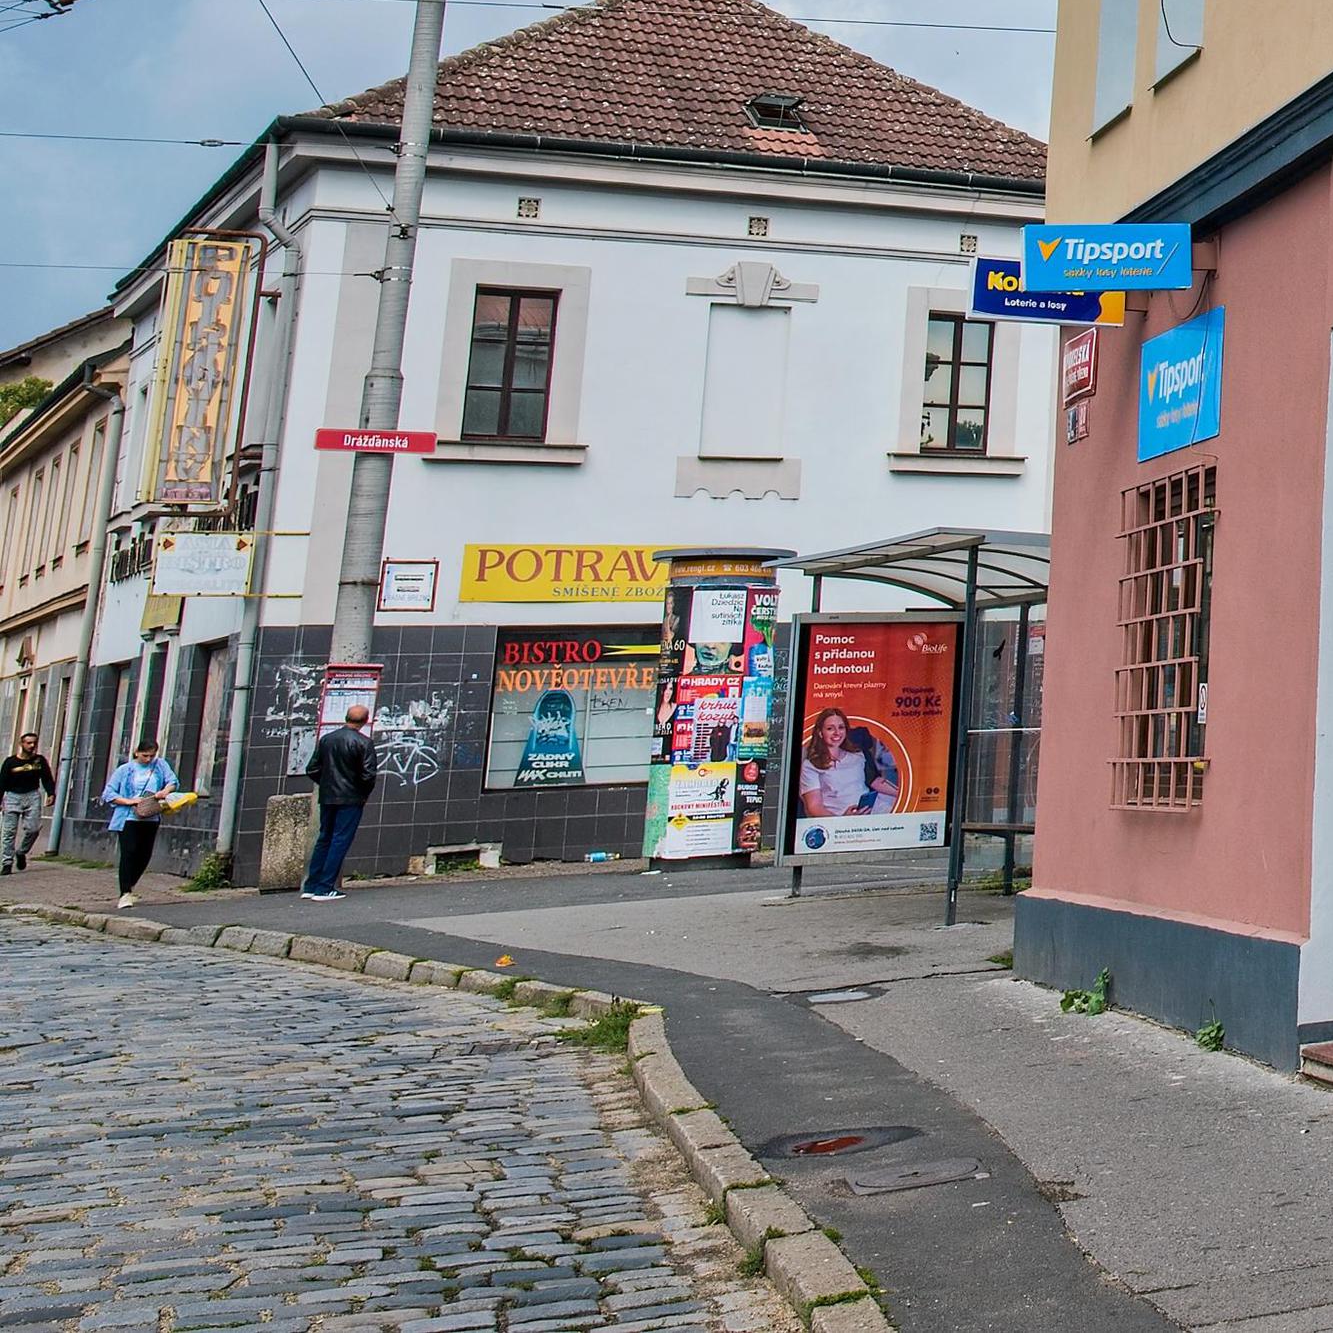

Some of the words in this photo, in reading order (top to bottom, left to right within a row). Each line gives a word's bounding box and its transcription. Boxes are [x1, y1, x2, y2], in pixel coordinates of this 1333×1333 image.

[1065, 238, 1165, 265] Tipsport
[1004, 297, 1038, 308] Loterie
[1039, 300, 1046, 309] a
[1047, 300, 1067, 312] losy
[475, 548, 670, 582] POTRAV
[816, 634, 855, 644] Pomoc
[503, 640, 602, 665] BISTRO
[814, 663, 874, 674] hodnotou!
[895, 696, 920, 708] 900
